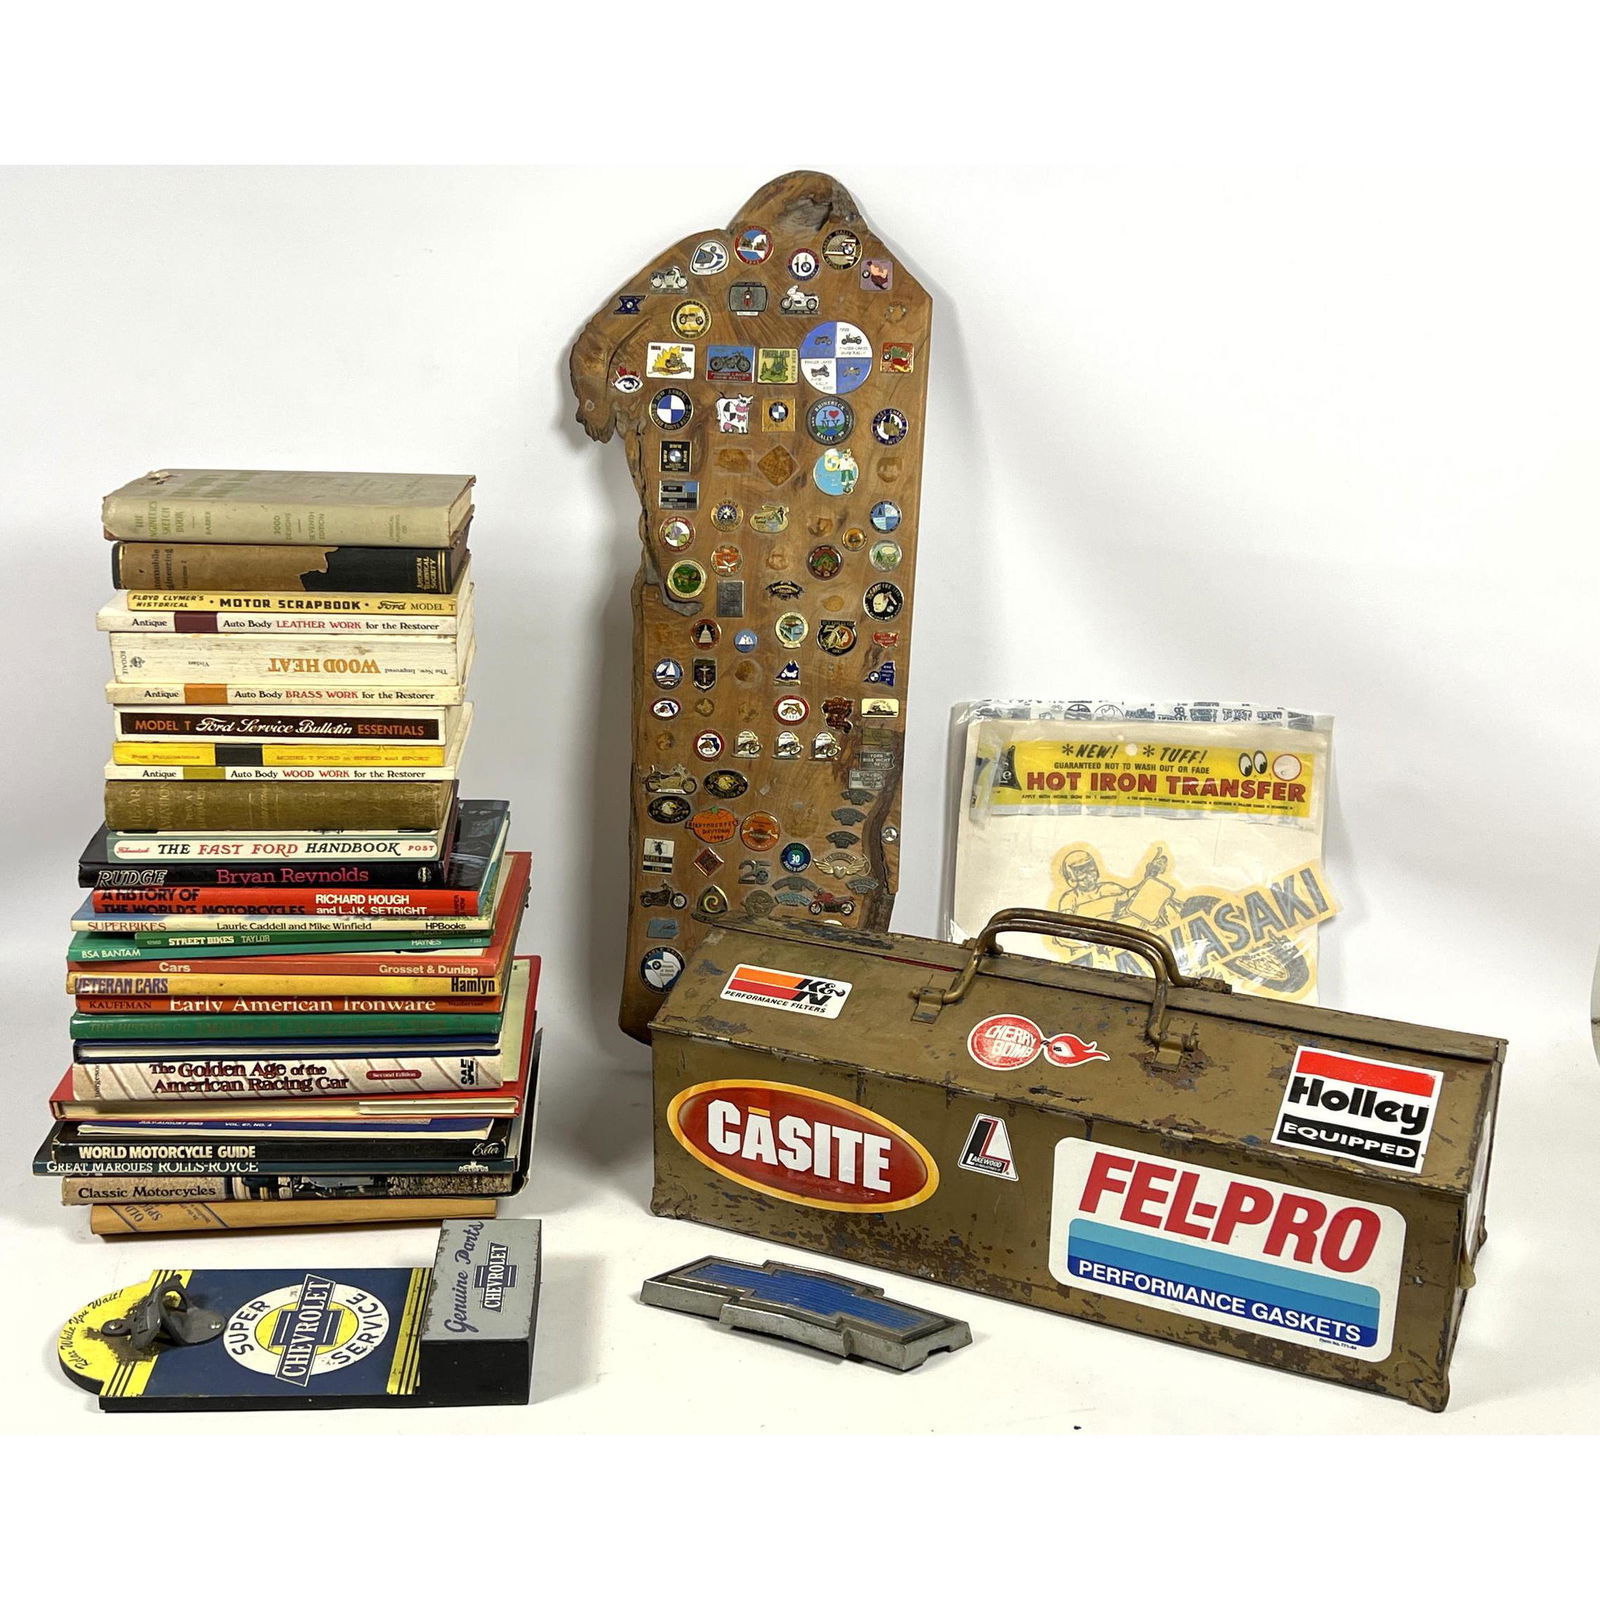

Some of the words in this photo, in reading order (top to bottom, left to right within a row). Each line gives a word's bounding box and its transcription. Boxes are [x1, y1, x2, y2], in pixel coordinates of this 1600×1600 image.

[220, 599, 271, 608] MOTOR
[278, 600, 361, 610] SCRAPBOOK
[377, 600, 406, 611] Ford
[410, 603, 445, 611] MODEL
[132, 618, 167, 628] Antique
[223, 619, 246, 628] Auto
[248, 620, 272, 629] Body
[276, 620, 325, 629] LEATHER
[329, 621, 362, 629] WORK
[365, 621, 378, 630] for
[382, 622, 397, 630] the
[400, 622, 440, 630] Restorer
[268, 657, 321, 673] HEAT
[323, 658, 381, 674] WOOD
[144, 690, 179, 698] Antique
[259, 691, 283, 699] Body
[285, 690, 323, 699] BRASS
[326, 691, 359, 699] WORK
[362, 691, 375, 699] for
[378, 691, 393, 699] the
[396, 691, 435, 700] Restorer
[135, 720, 179, 731] MODEL
[184, 720, 192, 731] T
[195, 717, 236, 732] Ford
[236, 718, 294, 733] Service
[295, 719, 353, 734] Bulletin
[357, 724, 425, 736] ESSENTIALS
[1075, 744, 1119, 759] NEW!
[1159, 747, 1208, 764] TUFF!
[142, 770, 177, 778] Antique
[231, 770, 253, 778] Auto
[255, 770, 279, 779] Body
[282, 770, 315, 778] WOOD
[318, 770, 350, 778] WORK
[354, 770, 367, 778] for
[1105, 762, 1119, 770] NOT
[1135, 763, 1156, 771] WASH
[1159, 764, 1174, 772] OUT
[1178, 765, 1188, 773] OR
[1191, 766, 1210, 774] FADE
[1027, 772, 1081, 791] HOT
[1091, 772, 1157, 793] IRON
[1166, 776, 1306, 803] TRANSFER
[158, 844, 190, 854] THE
[197, 844, 244, 855] FAST
[252, 844, 299, 857] FORD
[305, 843, 401, 856] HANDBOOK
[95, 870, 168, 888] RUDGE
[216, 869, 276, 884] Bryan
[280, 867, 369, 884] Reynolds
[101, 889, 113, 900] A
[116, 888, 176, 900] HISTORY
[179, 888, 200, 900] OF
[315, 894, 366, 904] RICHARD
[368, 894, 410, 905] HOUGH
[102, 904, 129, 914] THE
[132, 904, 197, 914] WORLD'S
[202, 905, 305, 915] MOTORCYCLES
[316, 906, 336, 914] and
[338, 907, 368, 915] L.J.K.
[370, 907, 427, 915] SETRIGHT
[87, 922, 167, 931] SUPERBIKES
[216, 922, 248, 930] Laurie
[250, 922, 286, 930] Caddell
[288, 922, 307, 930] and
[309, 922, 331, 930] Mike
[332, 922, 372, 930] Winfield
[425, 922, 466, 930] HPBooks
[168, 937, 206, 946] STREET
[207, 936, 235, 945] BIKES
[240, 935, 271, 943] TAYLOR
[81, 950, 99, 959] BSA
[101, 949, 141, 958] BANTAM
[159, 962, 191, 972] Cars
[379, 964, 425, 974] Grosset
[426, 966, 436, 974] &
[437, 966, 479, 976] Dunlap
[135, 978, 169, 994] CARS
[451, 977, 495, 994] Hamlyn
[89, 1001, 151, 1009] KAUFFMAN
[170, 998, 223, 1013] Early
[232, 997, 333, 1012] American
[343, 997, 436, 1011] Ironware
[724, 990, 789, 1007] PERFORMANCE
[790, 1002, 827, 1014] FILTERS
[984, 1025, 1037, 1046] CHERRY
[991, 1040, 1035, 1058] BOMB
[149, 1063, 176, 1074] The
[178, 1061, 246, 1077] Golden
[250, 1061, 287, 1079] Age
[290, 1064, 305, 1075] of
[306, 1064, 327, 1075] the
[460, 1059, 475, 1085] SAE
[152, 1078, 245, 1093] American
[248, 1078, 313, 1092] Racing
[315, 1077, 350, 1090] Car
[1287, 1076, 1430, 1136] Holley
[1282, 1122, 1416, 1159] EQUIPPED
[78, 1146, 127, 1159] WORLD
[129, 1146, 213, 1159] MOTORCYCLE
[217, 1145, 256, 1158] GUIDE
[966, 1152, 1003, 1169] LAKEWOOD
[46, 1162, 90, 1173] GREAT
[92, 1162, 153, 1173] MARQUES
[157, 1162, 259, 1173] ROLLS-ROYCE
[78, 1186, 128, 1199] Classic
[132, 1186, 216, 1199] Motorcycles
[1078, 1152, 1381, 1273] FEL-PRO
[454, 1221, 485, 1265] Parts
[484, 1245, 508, 1309] CHEVROLET
[444, 1270, 480, 1333] Genuine
[1079, 1260, 1246, 1315] PERFORMANCE
[1251, 1302, 1361, 1342] GASKETS
[60, 1325, 76, 1351] While
[68, 1310, 89, 1328] You
[87, 1289, 124, 1308] Wait!
[229, 1300, 271, 1356] SUPER
[330, 1292, 383, 1365] SERVICE
[281, 1280, 332, 1378] CHEVROLET
